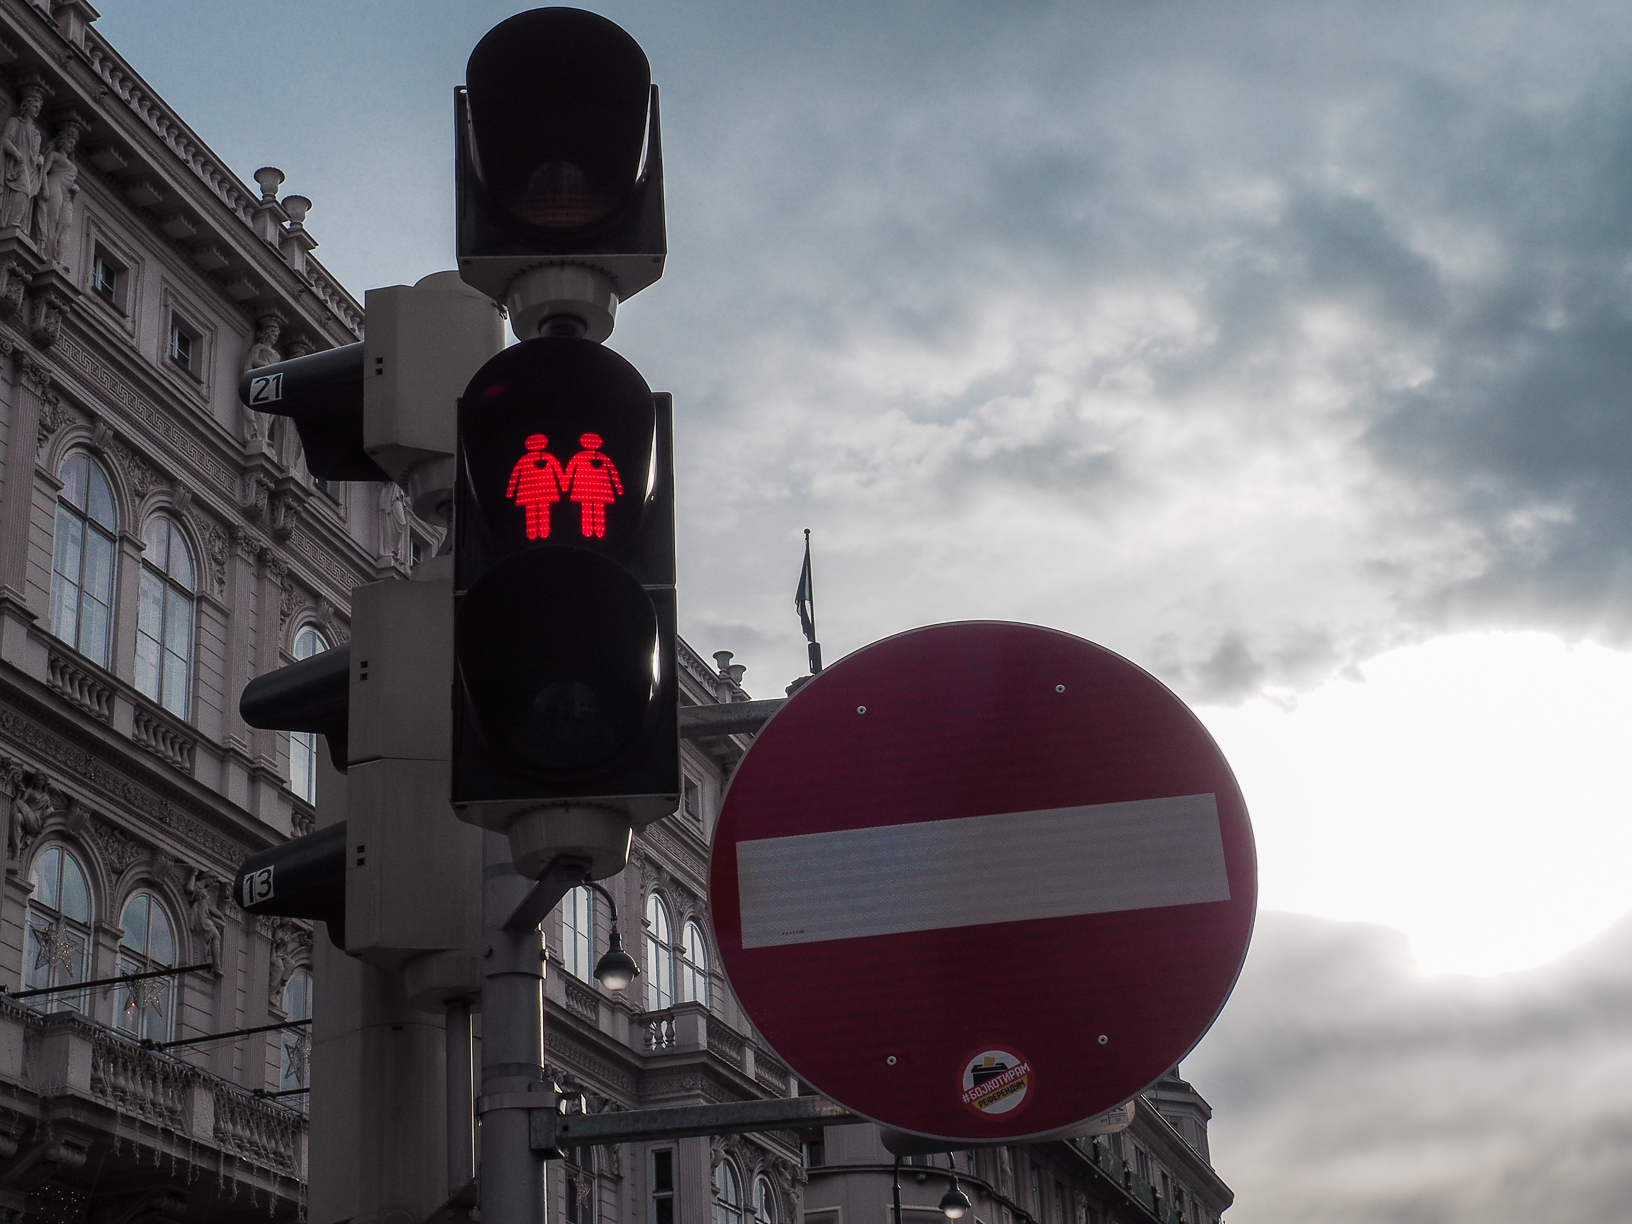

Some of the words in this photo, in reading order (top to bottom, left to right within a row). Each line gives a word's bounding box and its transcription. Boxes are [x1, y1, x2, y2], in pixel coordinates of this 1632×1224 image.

[252, 374, 282, 403] 21
[246, 868, 272, 904] 13
[978, 1080, 1026, 1109] РЕФЕРЕНДУМ
